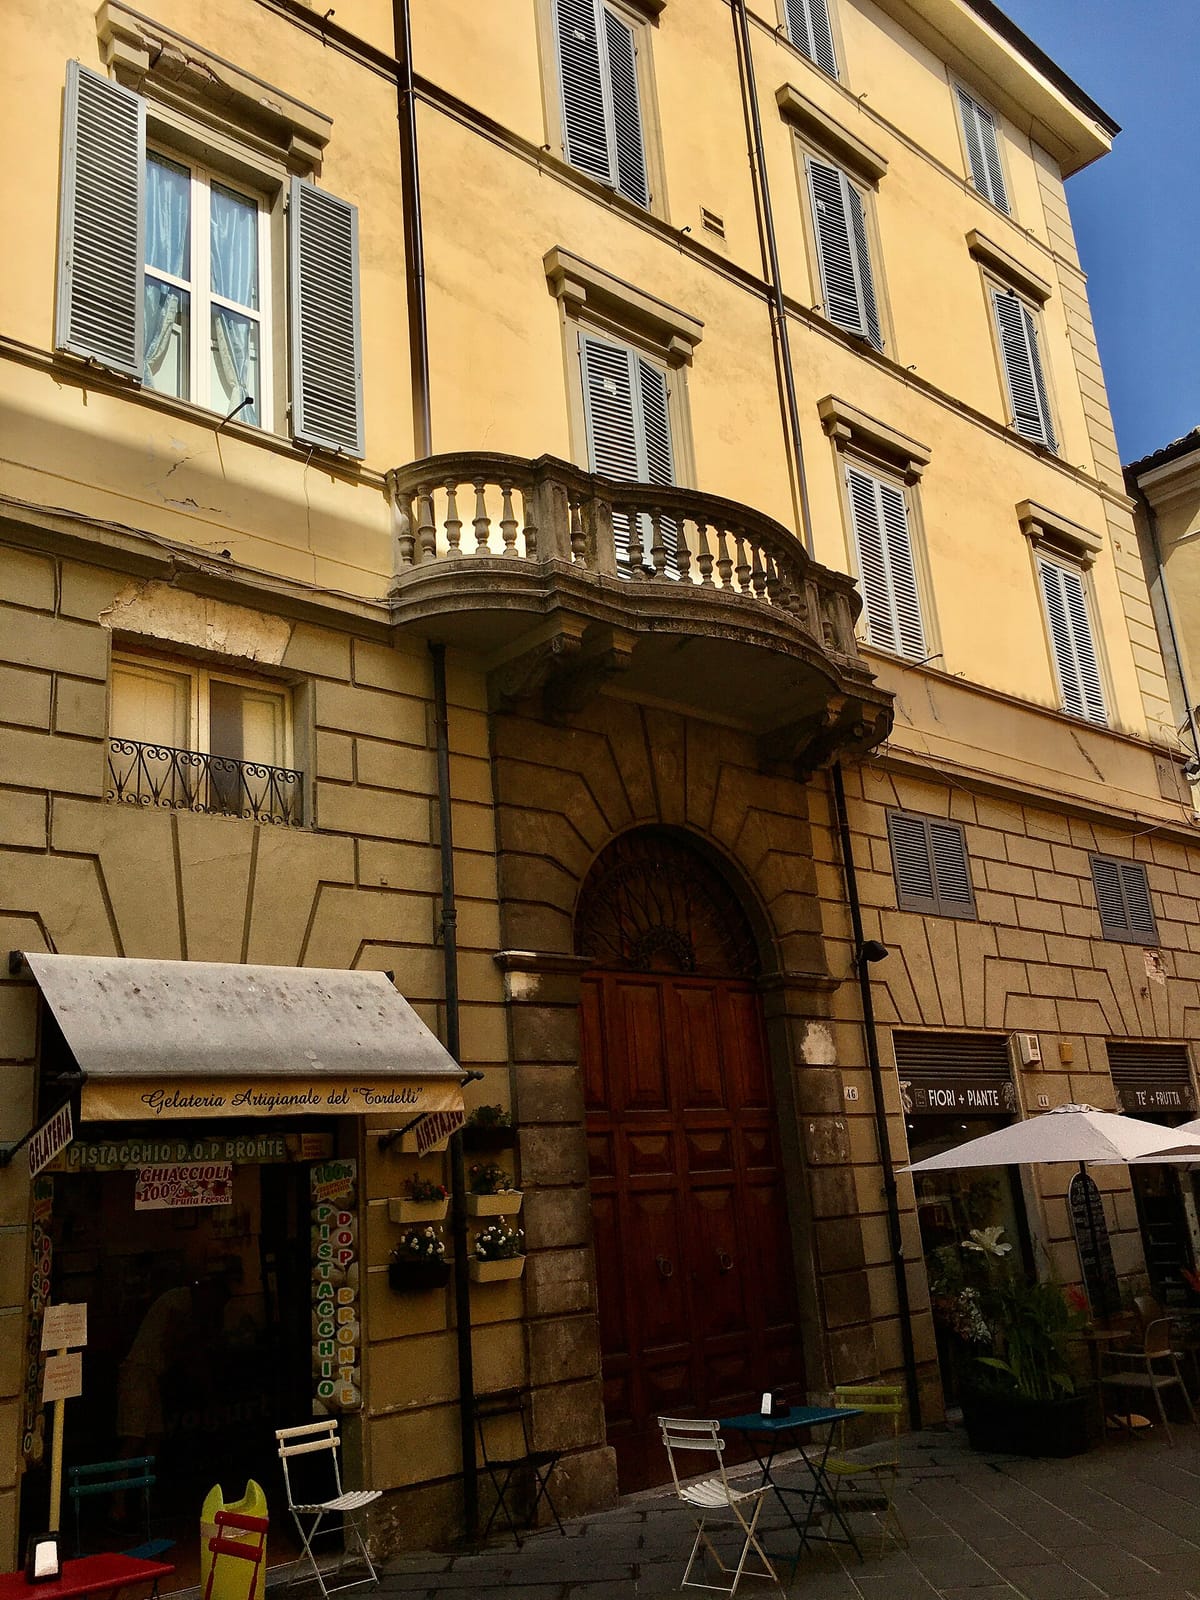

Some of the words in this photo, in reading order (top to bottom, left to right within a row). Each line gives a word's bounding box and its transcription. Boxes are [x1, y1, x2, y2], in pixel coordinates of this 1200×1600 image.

[141, 1089, 226, 1113] Gelateria
[231, 1088, 321, 1111] Artigianale
[327, 1088, 349, 1105] del
[928, 1089, 956, 1106] FIORI
[967, 1089, 999, 1106] PIANTE
[1156, 1091, 1181, 1105] FRUTTA
[30, 1107, 71, 1174] GELATERIA
[69, 1143, 171, 1166] PISTACCHIO
[225, 1139, 285, 1160] BRONTE
[140, 1166, 230, 1183] GHIACCIOLI
[142, 1183, 184, 1202] 100%
[171, 1197, 198, 1206] Frutta
[201, 1195, 229, 1204] Fresca
[338, 1213, 352, 1264] DOP
[318, 1207, 334, 1396] PISTACCHIO
[338, 1287, 354, 1403] BRONTE
